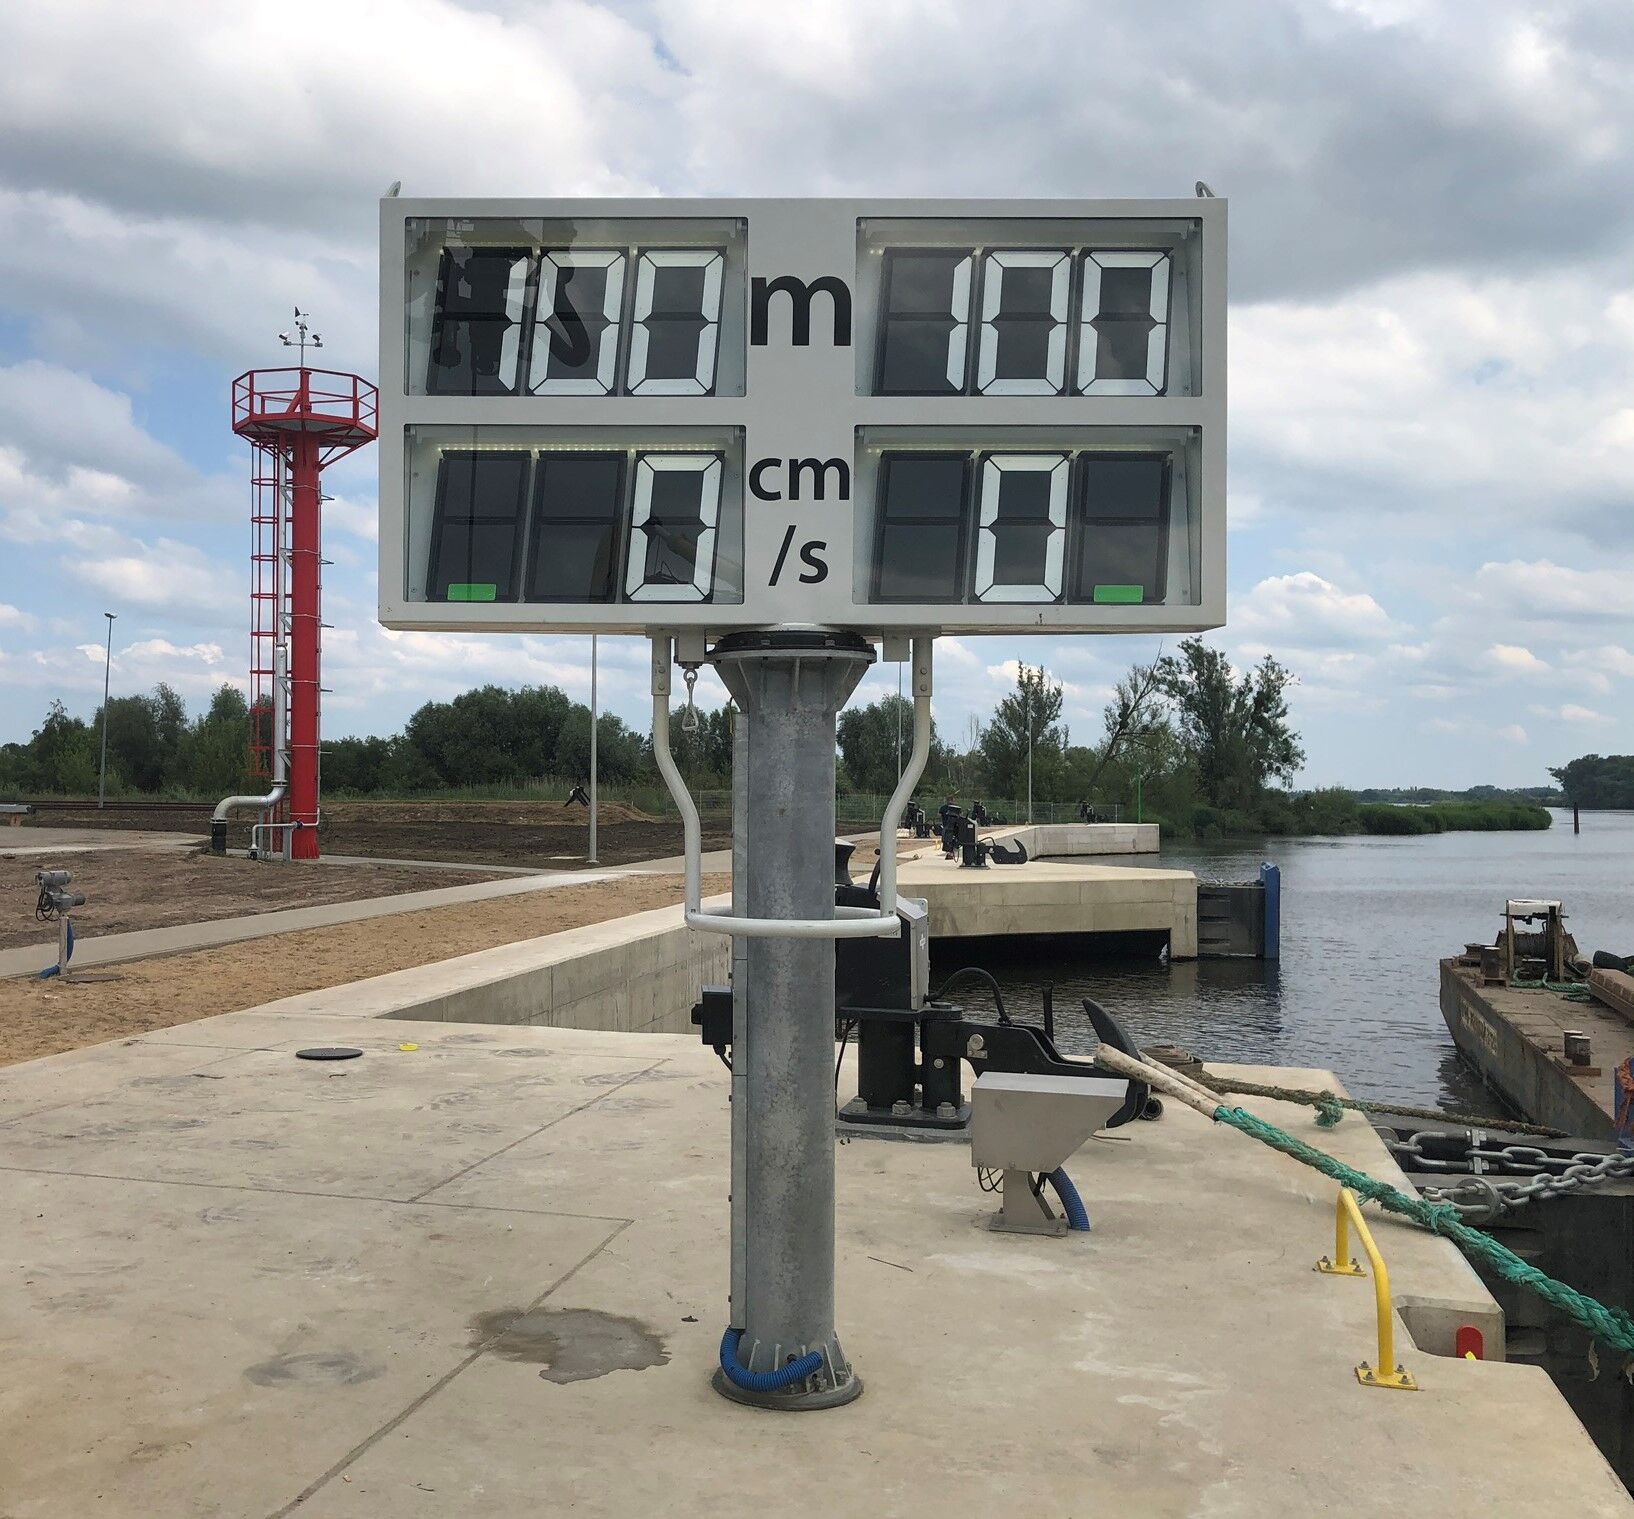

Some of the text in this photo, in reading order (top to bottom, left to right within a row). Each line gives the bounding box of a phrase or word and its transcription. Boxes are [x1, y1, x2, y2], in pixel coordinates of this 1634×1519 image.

[499, 251, 724, 396] 100
[750, 276, 852, 346] m
[947, 251, 1169, 396] 100
[625, 454, 722, 603] 0
[748, 456, 850, 502] cm
[975, 454, 1069, 603] 0
[768, 525, 830, 587] /s
